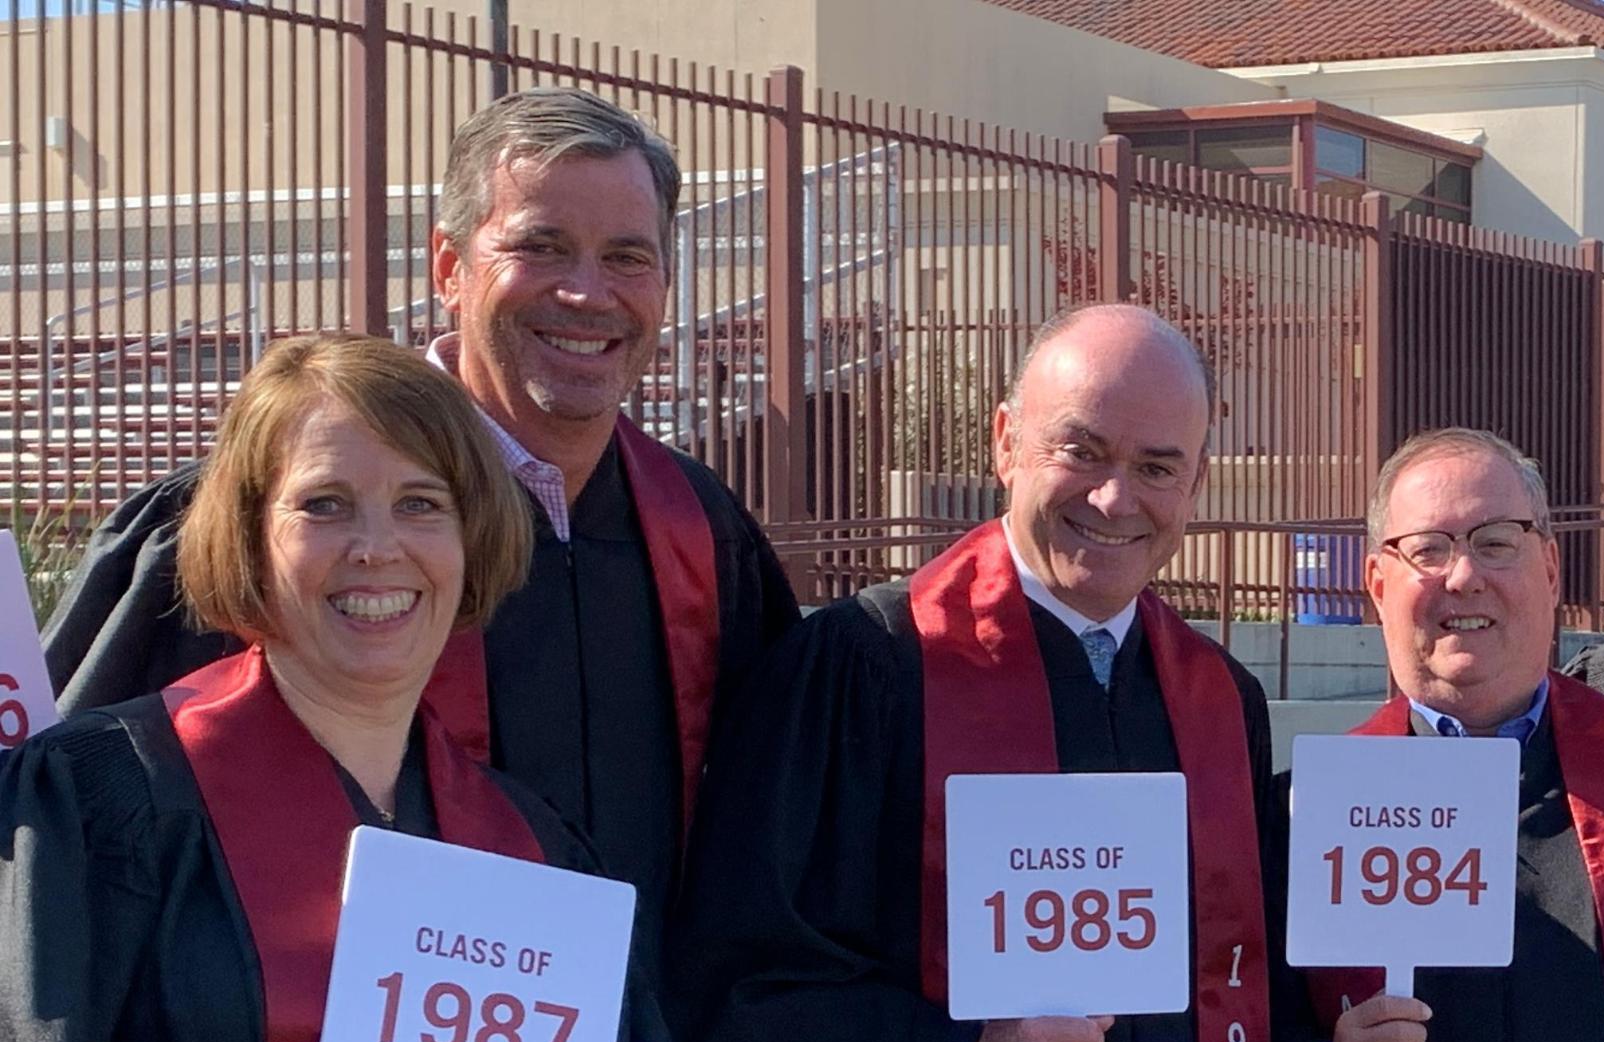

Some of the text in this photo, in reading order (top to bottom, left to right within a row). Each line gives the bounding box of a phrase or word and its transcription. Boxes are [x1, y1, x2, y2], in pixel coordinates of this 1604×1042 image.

[1349, 806, 1458, 829] CLASS OF
[1009, 846, 1124, 871] CLASS OF
[1323, 845, 1488, 906] 1984
[983, 888, 1157, 954] 1985
[415, 926, 553, 977] CLASS OF
